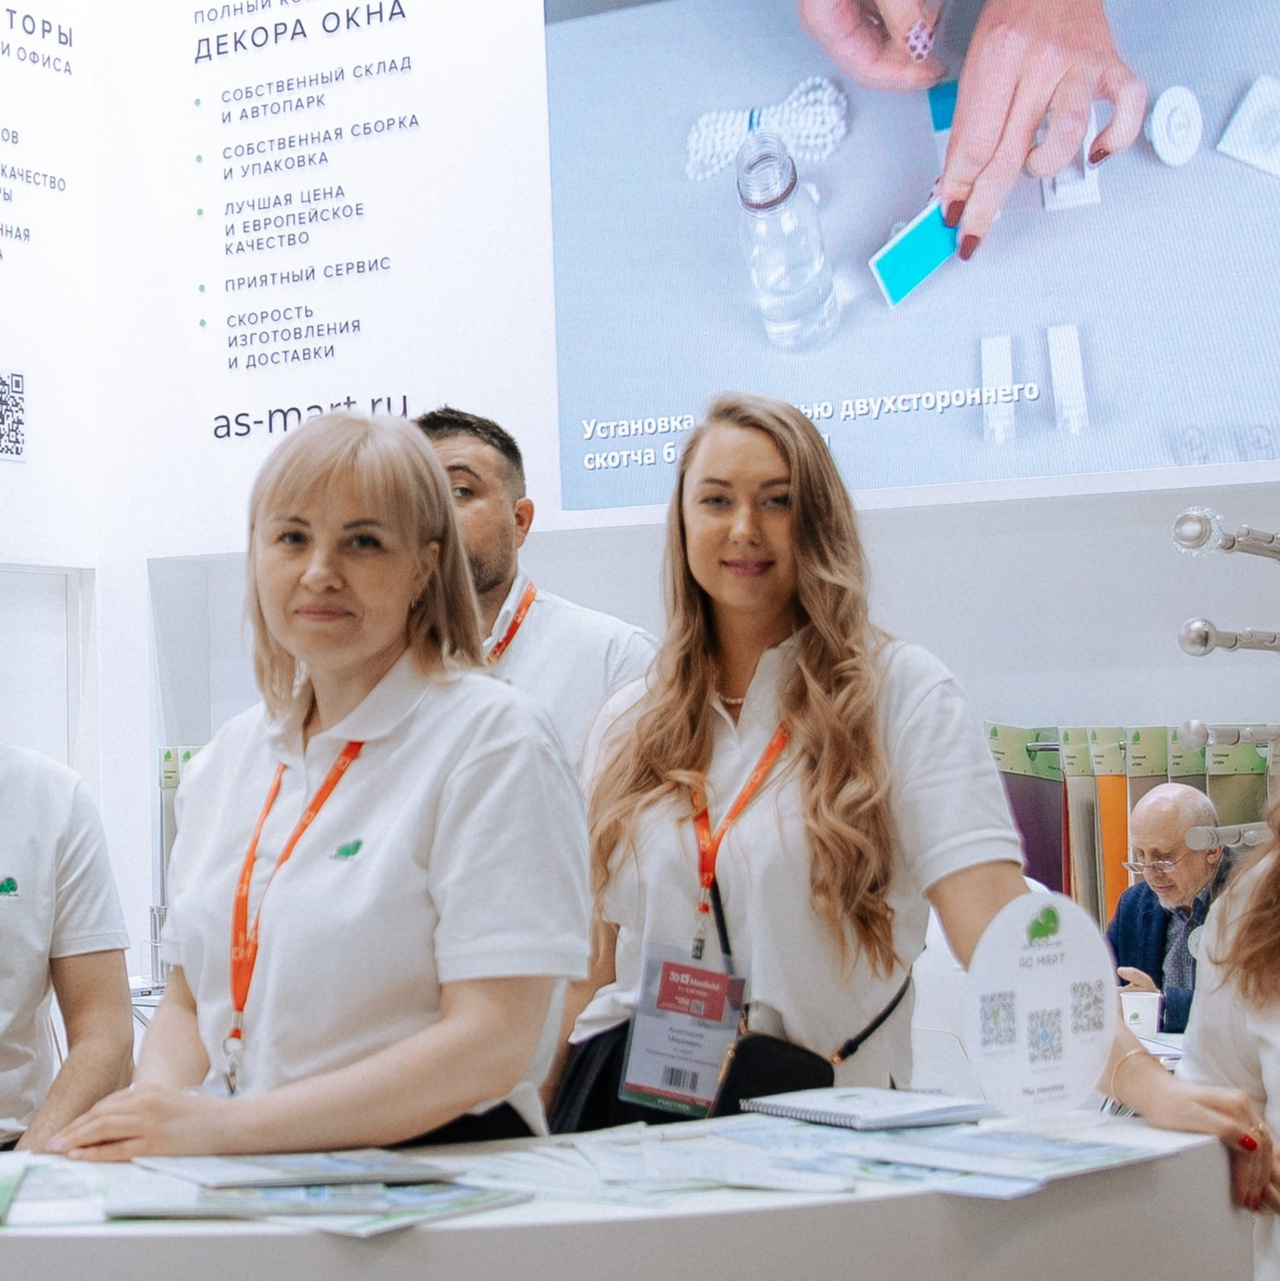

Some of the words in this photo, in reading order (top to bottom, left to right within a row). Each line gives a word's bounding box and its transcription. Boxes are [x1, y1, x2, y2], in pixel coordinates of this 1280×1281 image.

[195, 18, 307, 64] ДЕКОРА
[1, 41, 10, 57] И
[17, 46, 72, 76] ОФИСА
[221, 66, 345, 103] СОБСТВЕННЫЙ
[353, 56, 412, 79] СКЛАД
[222, 111, 231, 124] И
[239, 94, 325, 121] АВТОПАРК
[222, 127, 343, 160] СОБСТВЕННАЯ
[350, 114, 419, 137] СБОРКА
[1, 163, 66, 192] КАЧЕСТВО
[223, 167, 233, 181] И
[241, 151, 329, 178] УПАКОВКА
[224, 193, 292, 216] ЛУЧШАЯ
[300, 185, 345, 204] ЦЕНА
[225, 223, 235, 237] И
[243, 202, 364, 233] ЕВРОПЕЙСКОЕ
[225, 231, 309, 255] КАЧЕСТВО
[225, 265, 315, 292] ПРИЯТНЫЙ
[323, 256, 390, 278] СЕРВИС
[227, 305, 314, 328] СКОРОСТЬ
[228, 319, 360, 348] ИЗГОТОВЛЕНИЯ
[228, 356, 238, 369] И
[245, 344, 334, 370] ДОСТАВКИ
[213, 395, 407, 439] as-maru
[582, 412, 695, 440] Установка
[840, 382, 1040, 421] двухстороннего
[583, 447, 656, 470] скотча
